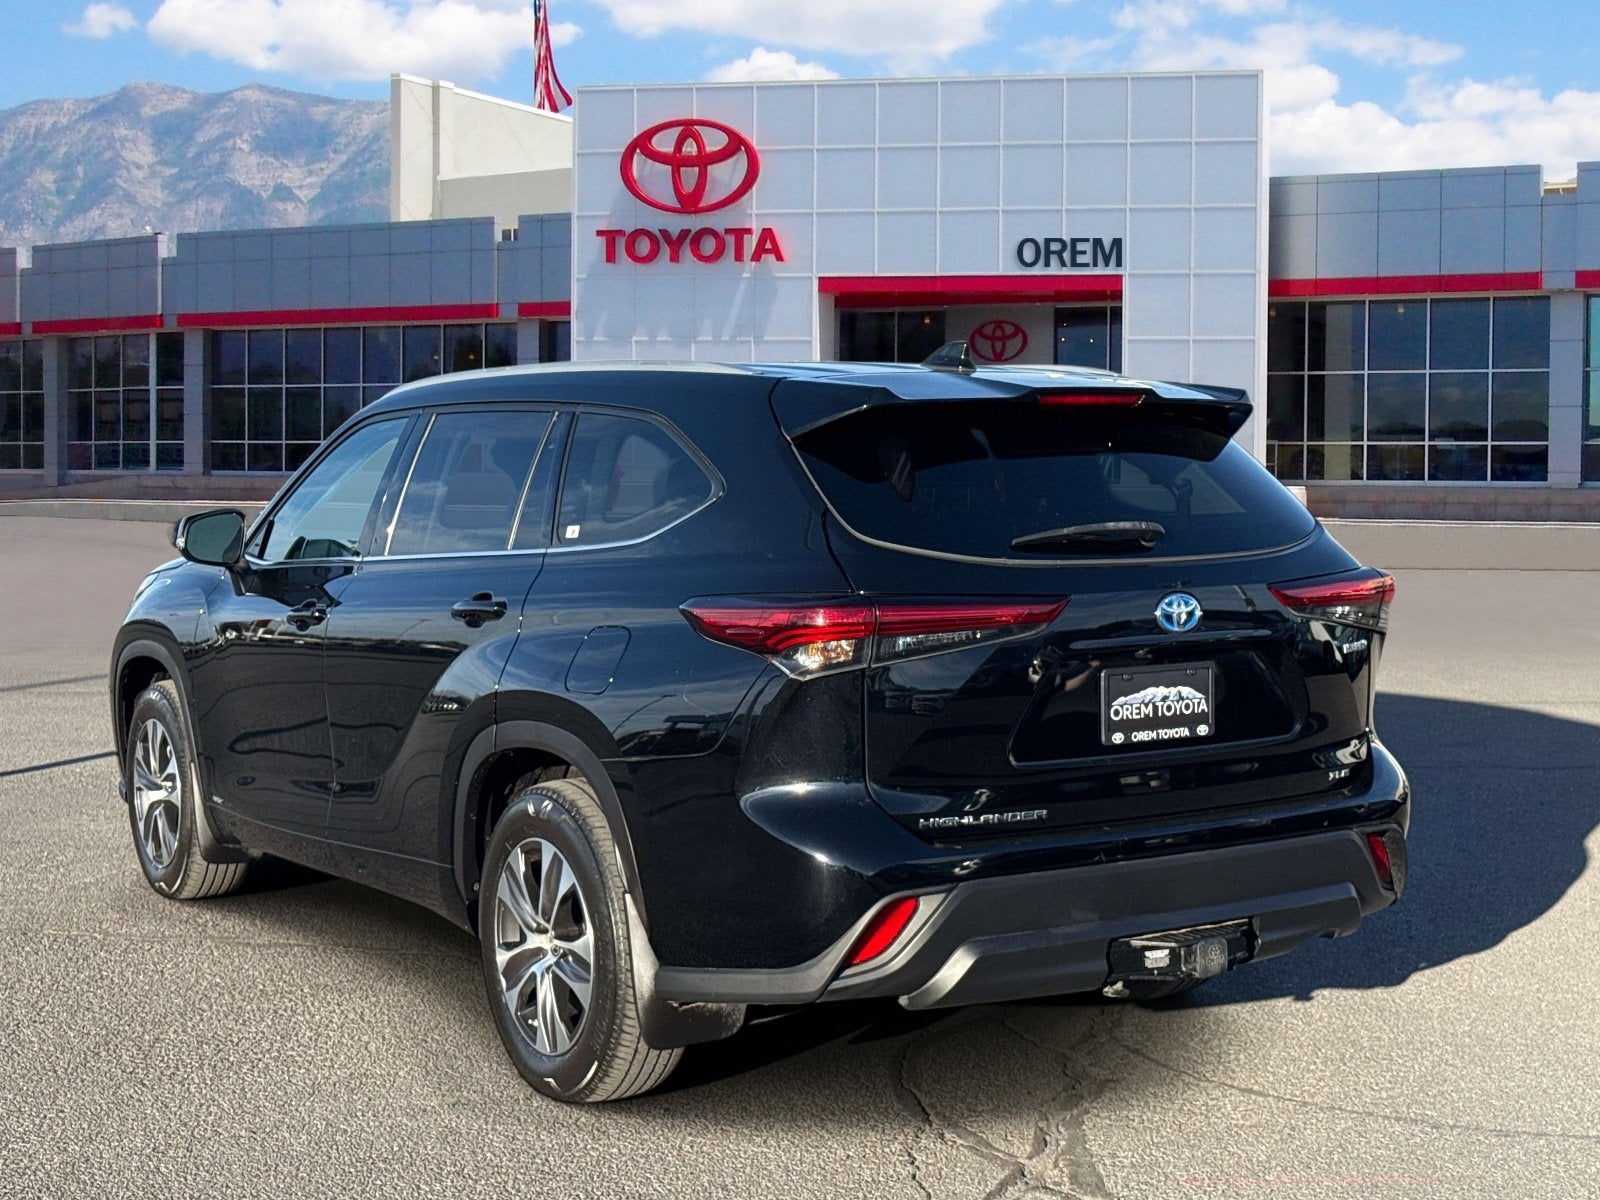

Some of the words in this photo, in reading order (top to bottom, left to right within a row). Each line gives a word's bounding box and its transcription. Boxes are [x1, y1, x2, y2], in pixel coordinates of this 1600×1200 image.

[595, 227, 785, 264] TOYOTA
[1016, 237, 1123, 268] OREM
[1110, 702, 1153, 721] OREM
[1156, 698, 1208, 716] TOYOTA
[1131, 730, 1156, 742] OREM
[1158, 727, 1190, 739] TOYOTA
[918, 809, 1048, 829] HIGHLANDER
